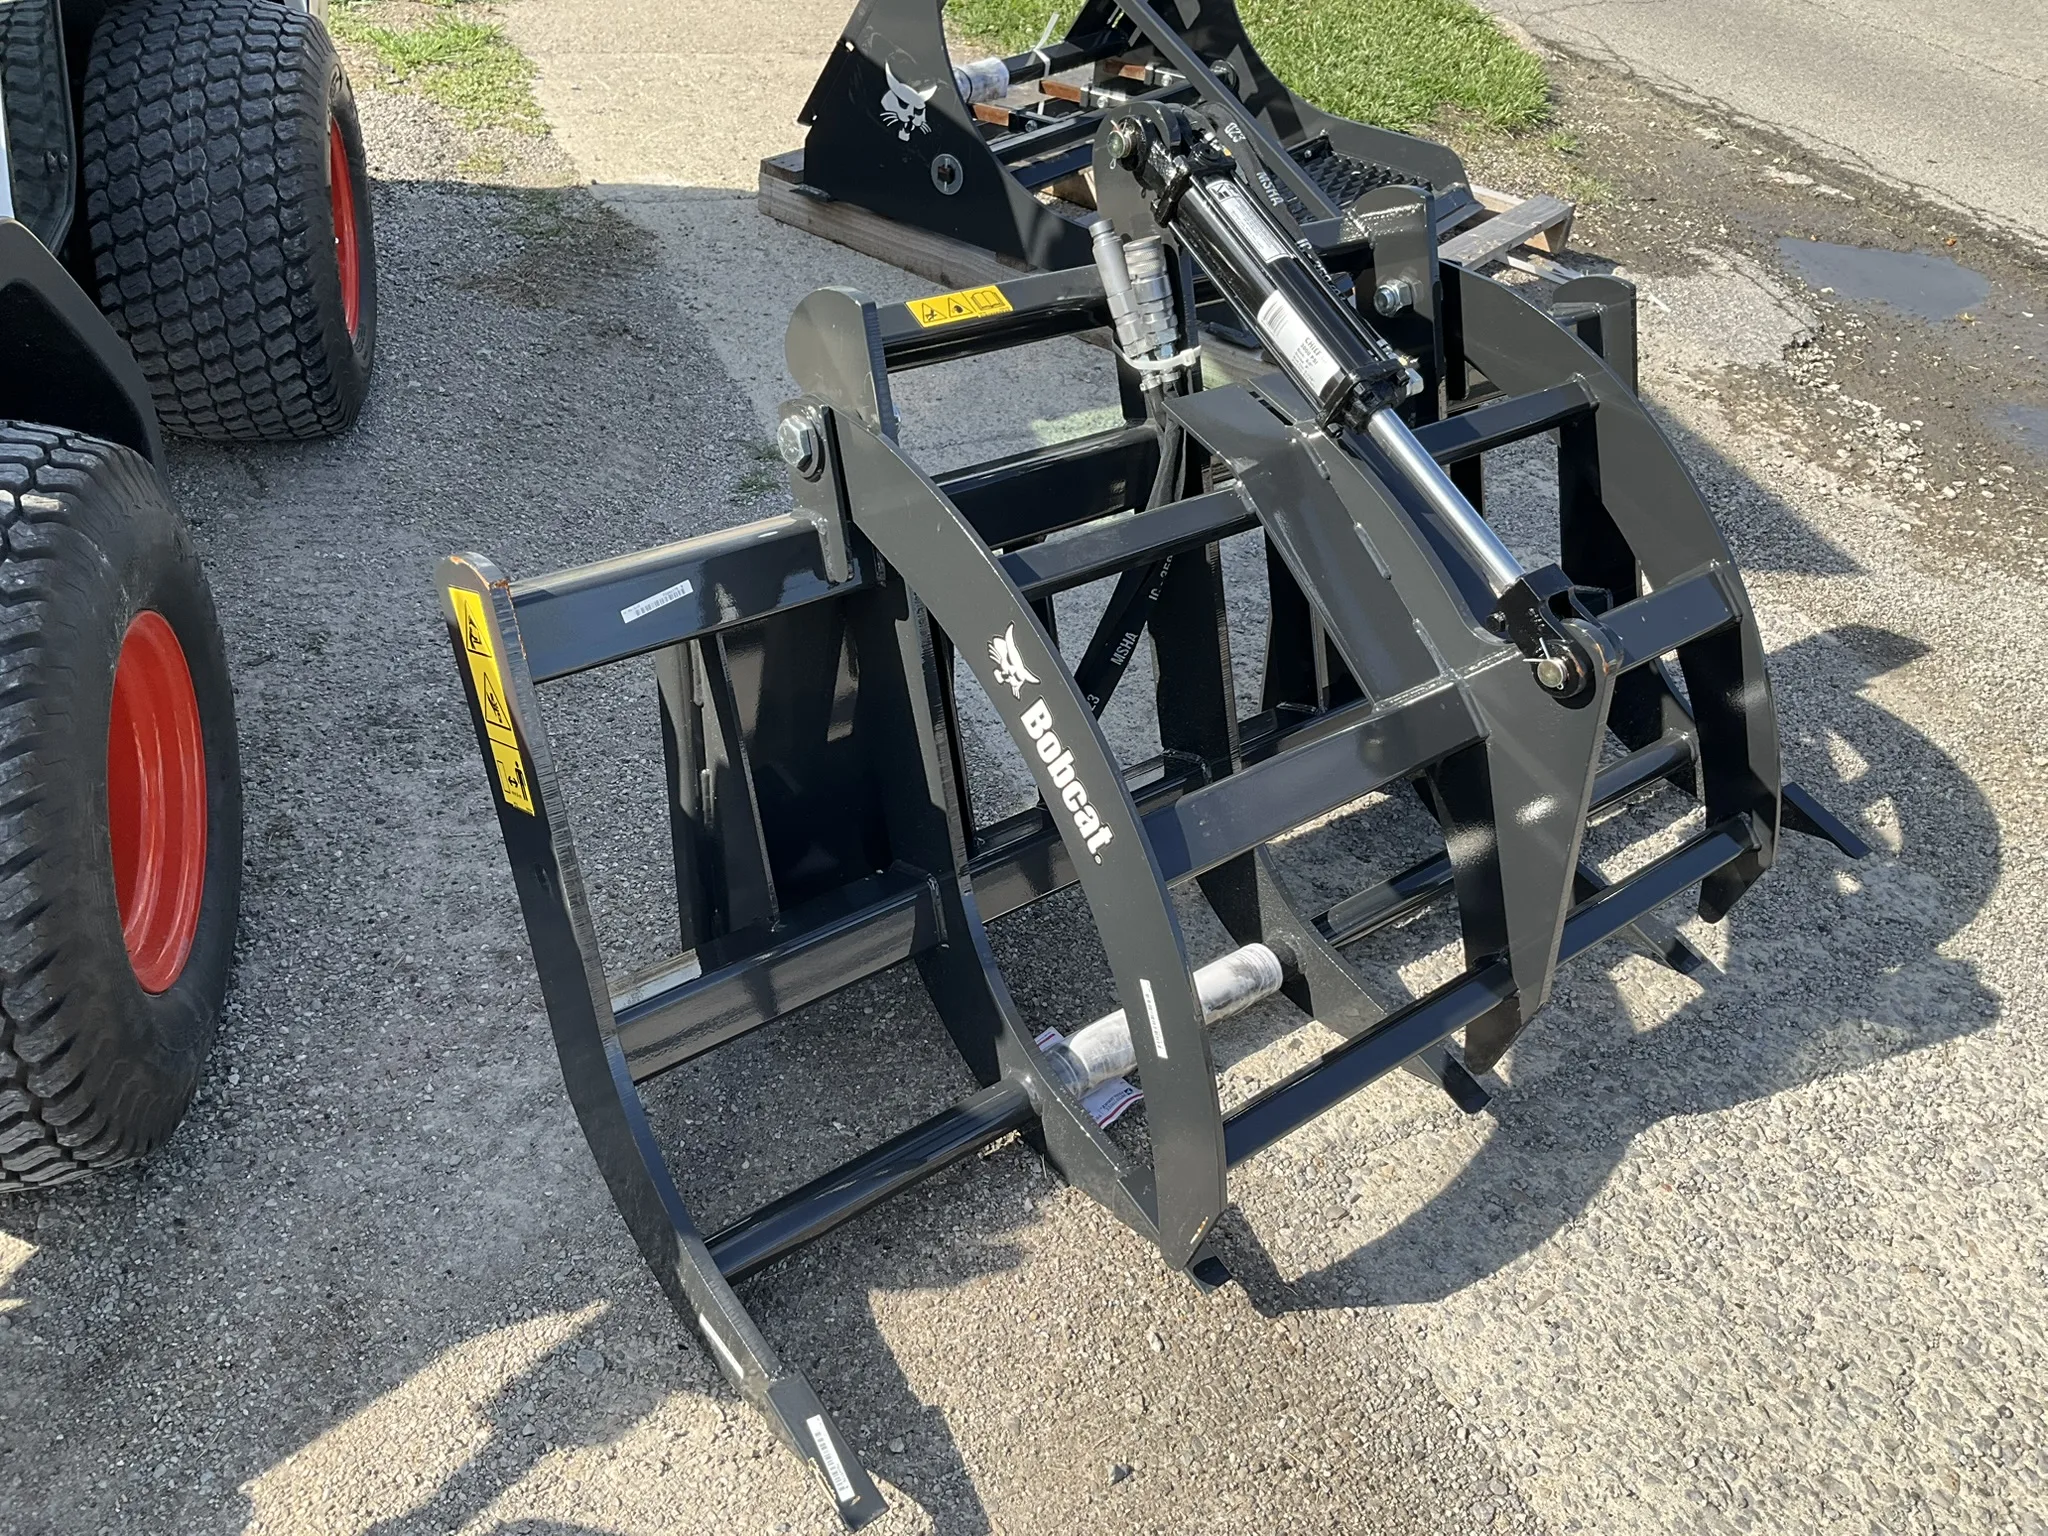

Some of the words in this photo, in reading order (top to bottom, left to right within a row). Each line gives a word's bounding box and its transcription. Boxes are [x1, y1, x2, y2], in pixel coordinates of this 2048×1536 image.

[1256, 171, 1284, 207] MSHA
[1110, 631, 1138, 666] MSHA
[1020, 696, 1113, 856] Bobcat
